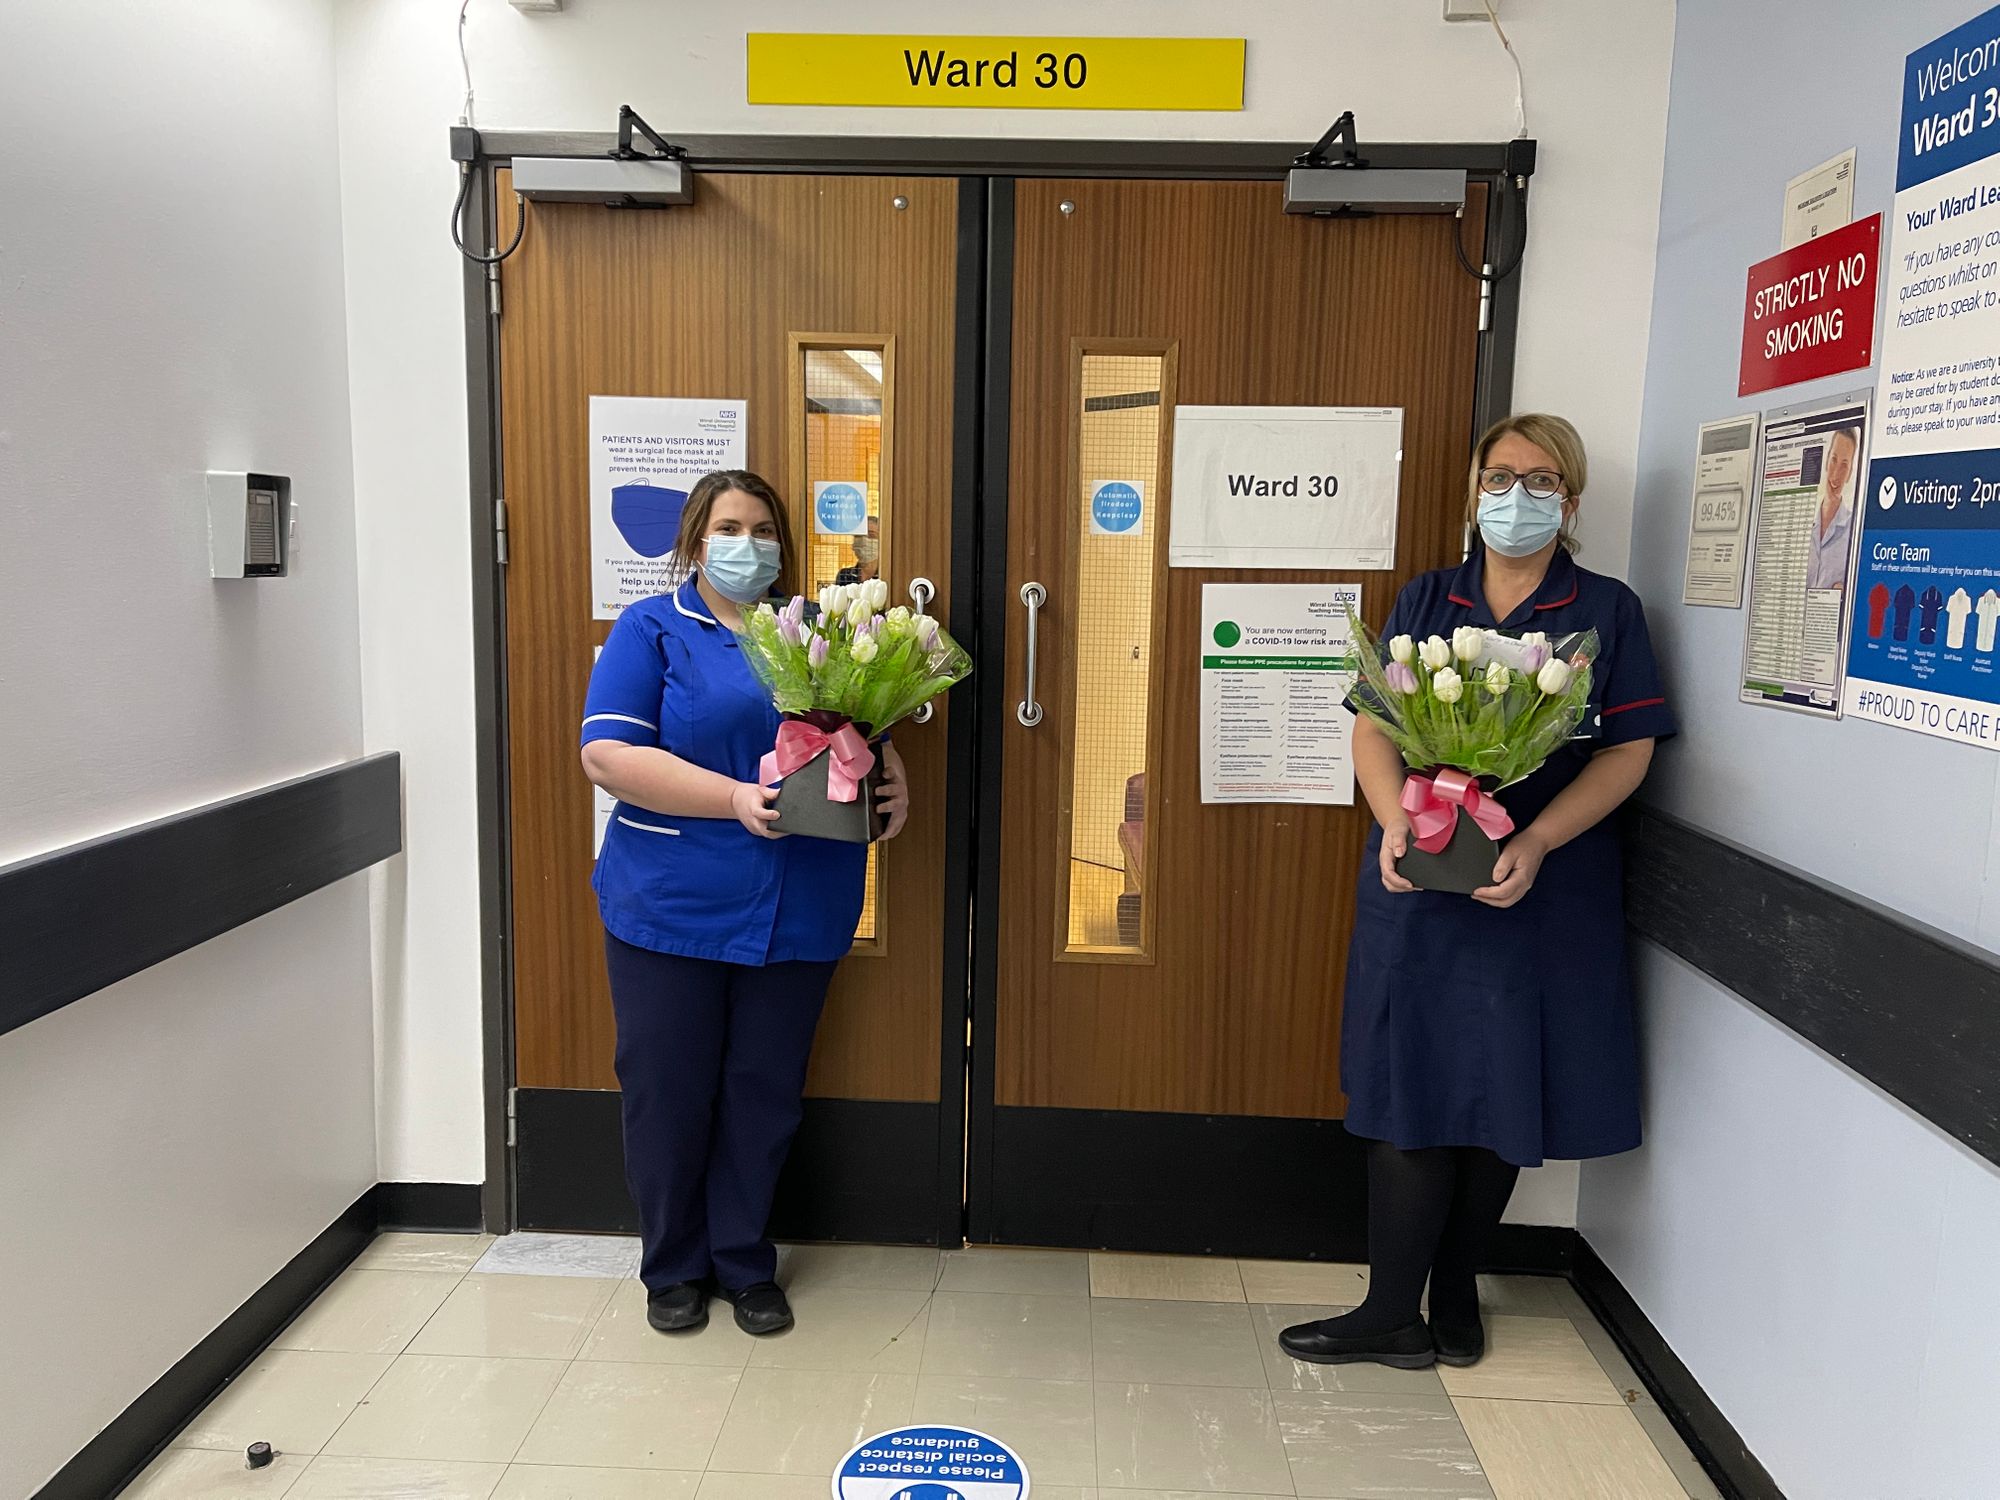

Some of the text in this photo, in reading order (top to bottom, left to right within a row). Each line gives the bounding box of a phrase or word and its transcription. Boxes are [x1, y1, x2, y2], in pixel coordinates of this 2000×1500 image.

[904, 50, 1088, 89] Ward 30
[1914, 87, 2000, 156] Ward 3
[1907, 187, 1977, 232] Your Ward
[1914, 234, 1985, 275] you have any
[1754, 253, 1866, 320] STRICTLY NO
[1900, 260, 1997, 304] questions whilst on
[1897, 290, 1996, 329] hesitate to speak to
[1764, 308, 1844, 360] SMOKING
[1916, 369, 1925, 380] As
[1927, 368, 1937, 378] we
[1939, 366, 1951, 376] are
[1952, 364, 1957, 374] a
[1959, 356, 1996, 373] university
[1889, 376, 1989, 403] may be cared for by student
[1888, 406, 1910, 419] during
[1911, 404, 1927, 418] your
[1946, 398, 1952, 410] If
[1953, 400, 1967, 413] you
[1969, 395, 1988, 407] have
[1901, 422, 1922, 436] please
[1924, 417, 1944, 433] speak
[1947, 418, 1954, 428] to
[1956, 417, 1974, 431] your
[1976, 411, 1996, 425] ward
[602, 435, 643, 444] PATIENTS
[665, 437, 705, 446] VISITORS
[707, 438, 731, 447] MUST
[635, 447, 664, 455] surgical
[680, 458, 709, 466] hospital
[1228, 474, 1339, 497] Ward 30
[1903, 478, 1962, 510] Visiting:
[1701, 501, 1736, 522] 99.45%
[1873, 543, 1930, 561] Core Team
[621, 577, 642, 587] Help
[1887, 563, 1900, 572] these
[1900, 564, 1921, 573] uniforms
[1938, 567, 1954, 576] caring
[1954, 566, 1962, 575] for
[1962, 569, 1973, 577] you
[1982, 567, 1992, 576] this
[1252, 637, 1292, 645] COVID-19
[1295, 628, 1327, 636] entering
[1859, 690, 1990, 739] #PROUD TO CARE
[891, 1437, 979, 1449] guidance
[860, 1449, 1007, 1463] social distance
[858, 1463, 1004, 1480] Please respect
